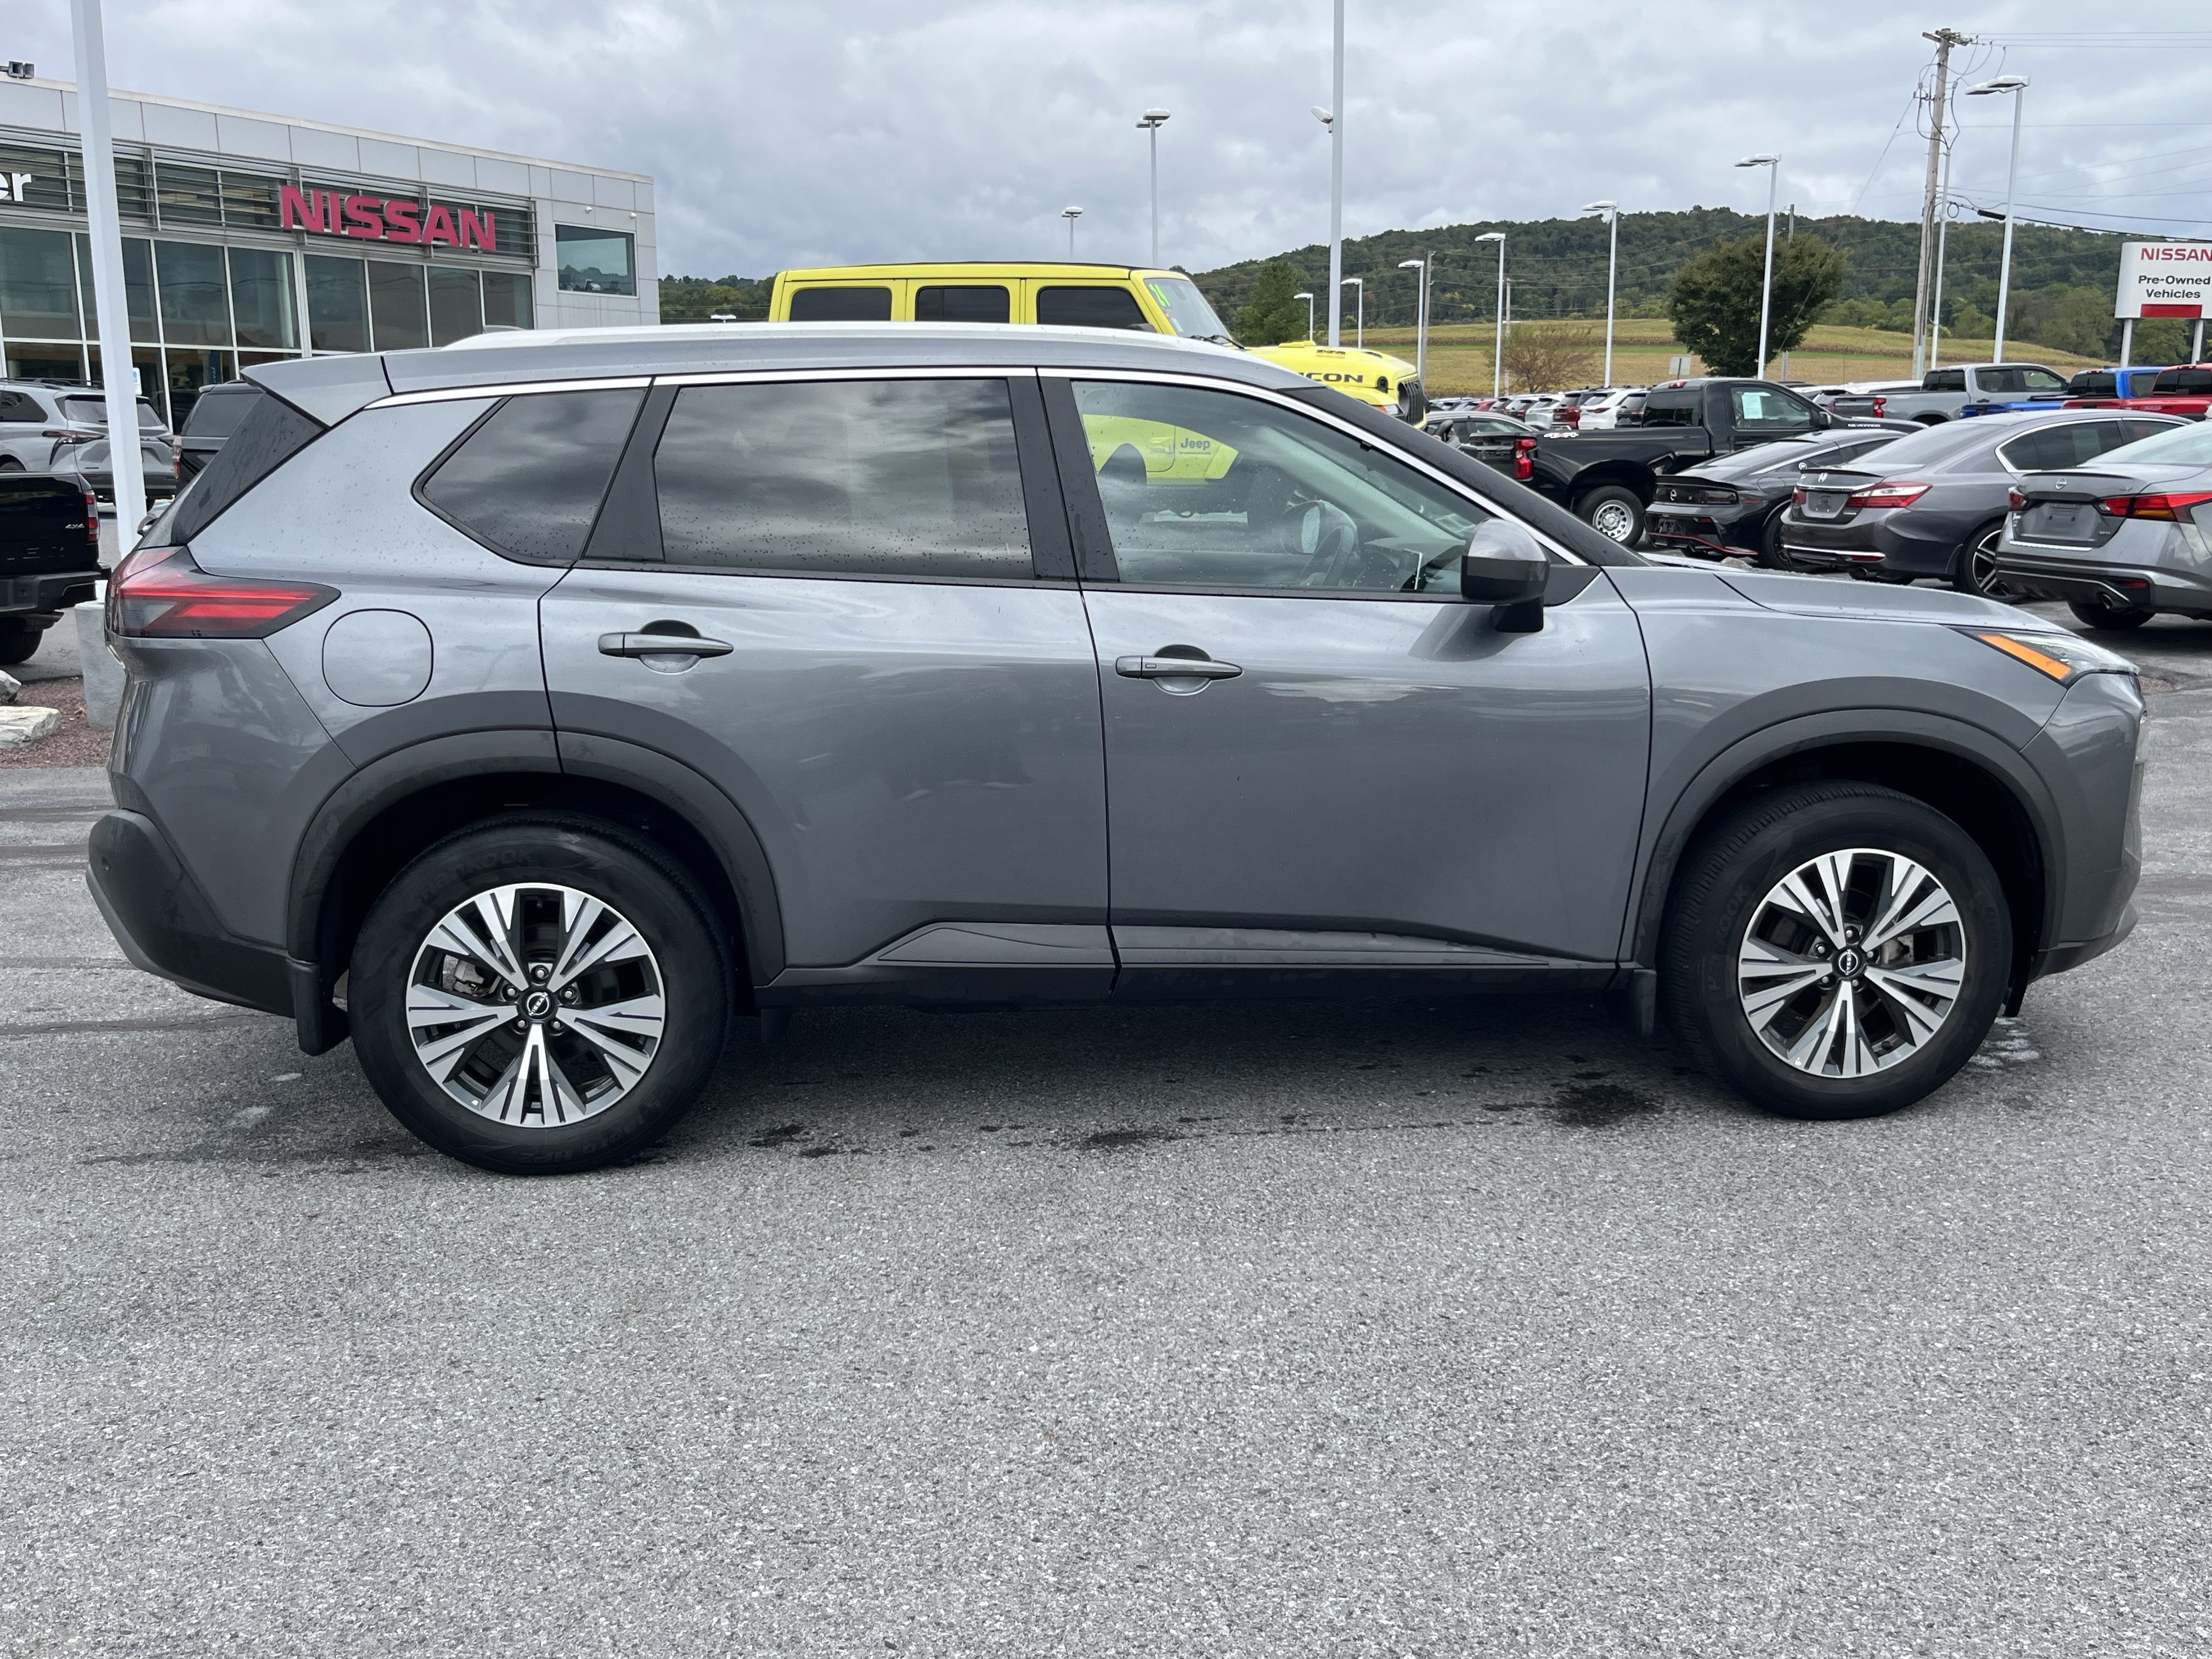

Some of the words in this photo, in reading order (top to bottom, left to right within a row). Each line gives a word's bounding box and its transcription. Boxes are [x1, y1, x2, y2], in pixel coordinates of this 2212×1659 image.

[280, 185, 496, 251] NISSAN
[2141, 248, 2212, 261] NISSAN
[2138, 275, 2211, 285] Pre-Owned
[2146, 289, 2201, 298] Vehicles
[1181, 438, 1210, 450] Jeep
